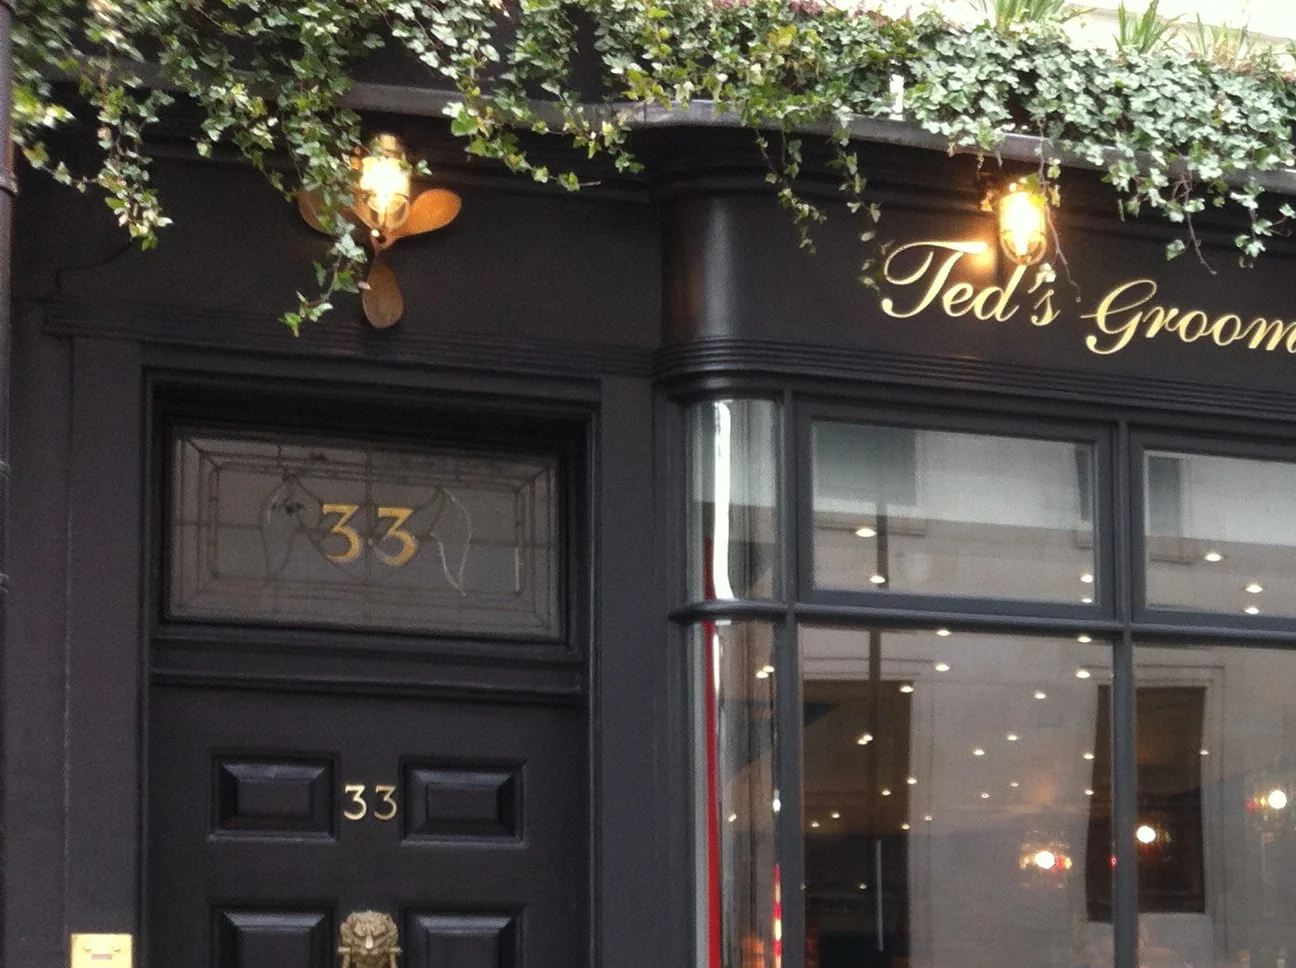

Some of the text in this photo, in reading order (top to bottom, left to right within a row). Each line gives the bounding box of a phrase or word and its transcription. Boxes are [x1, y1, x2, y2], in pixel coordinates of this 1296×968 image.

[881, 241, 1060, 326] Ted's
[322, 503, 418, 567] 33
[343, 784, 398, 821] 33
